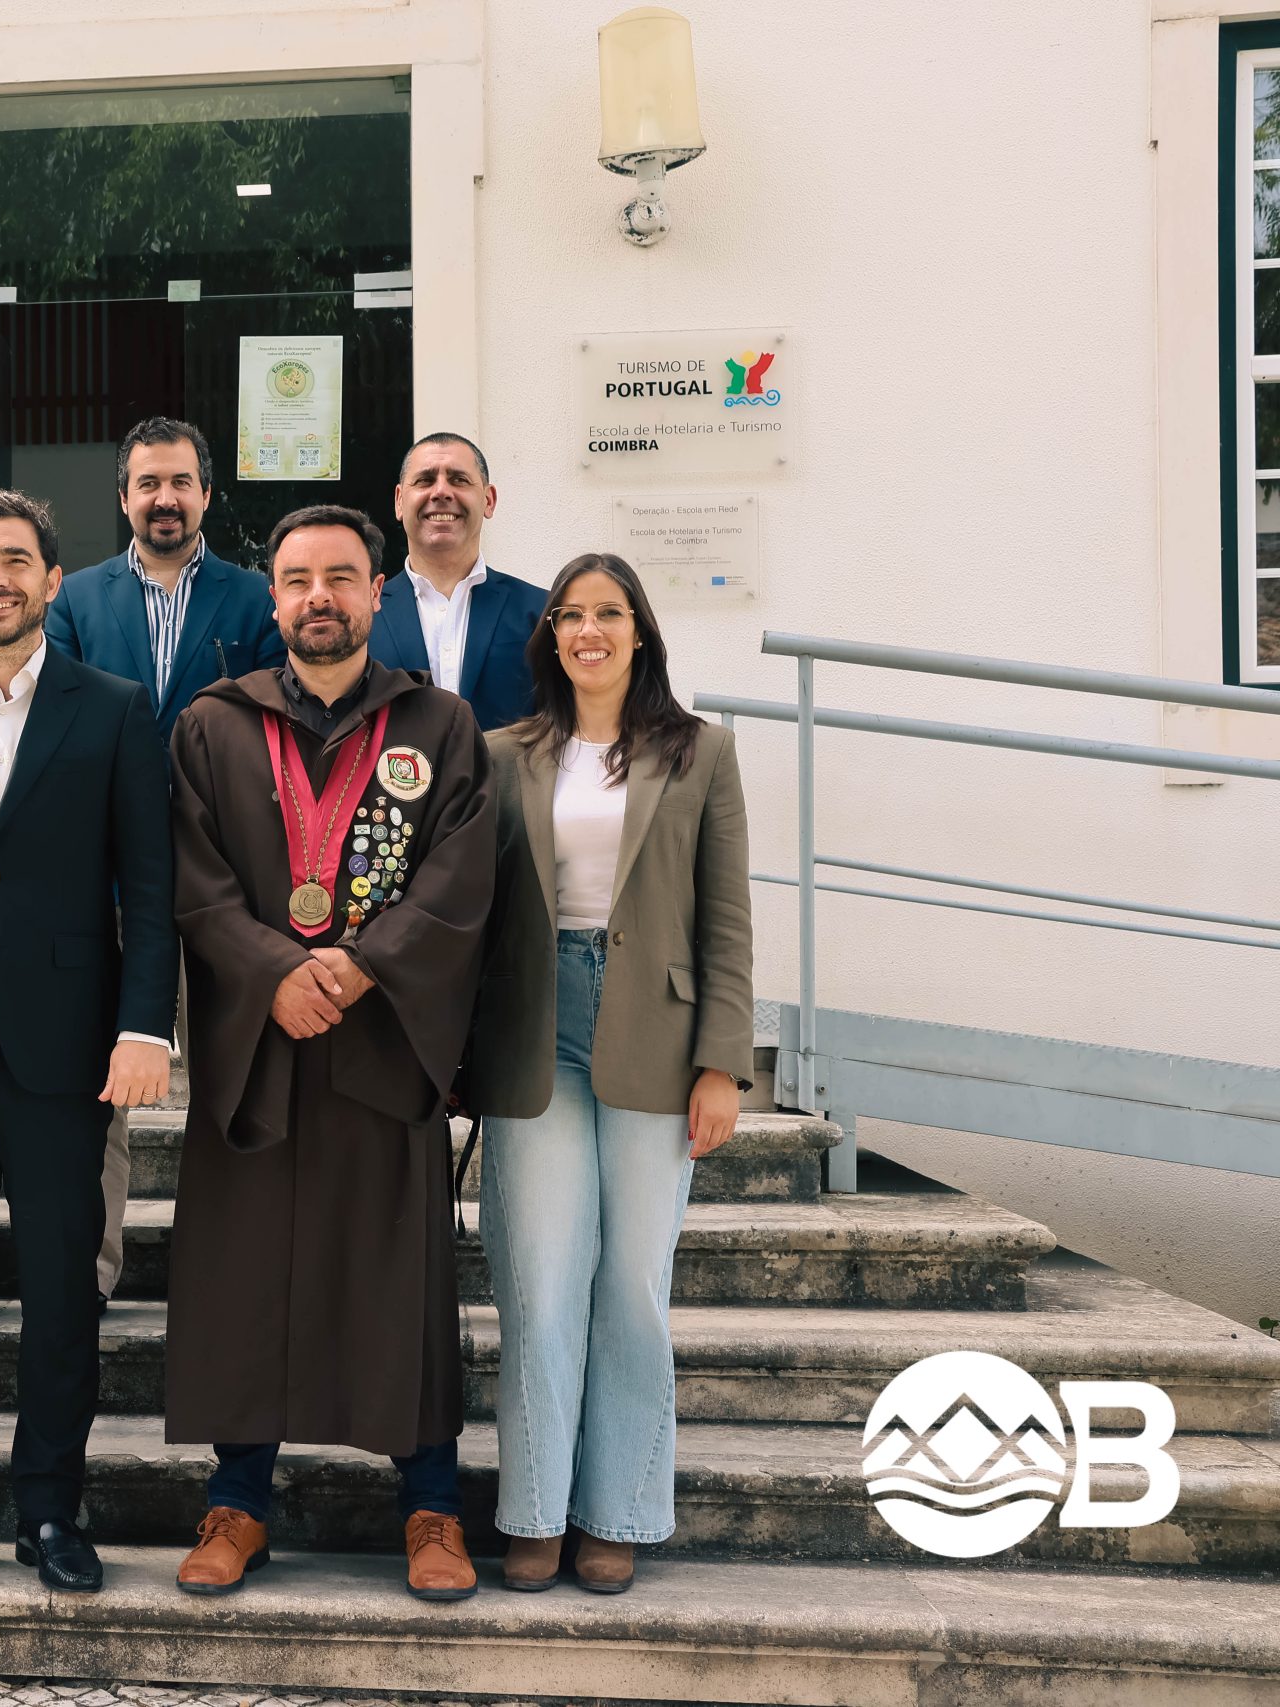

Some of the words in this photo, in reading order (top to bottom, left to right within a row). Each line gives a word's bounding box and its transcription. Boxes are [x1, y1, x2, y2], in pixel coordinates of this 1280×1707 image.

[272, 361, 309, 373] EcoXaropes
[617, 360, 681, 374] TURISMO
[687, 360, 705, 372] DE
[606, 380, 713, 398] PORTUGAL
[589, 425, 629, 437] Escola
[634, 424, 650, 436] de
[654, 422, 714, 435] Hotelaria
[718, 424, 726, 433] e
[730, 420, 782, 432] Turismo
[588, 439, 659, 452] COIMBRA
[632, 507, 670, 516] Operação
[677, 506, 703, 514] Escola
[630, 528, 655, 536] Escola
[669, 527, 703, 535] Hotelaria
[676, 537, 708, 545] Coimbra
